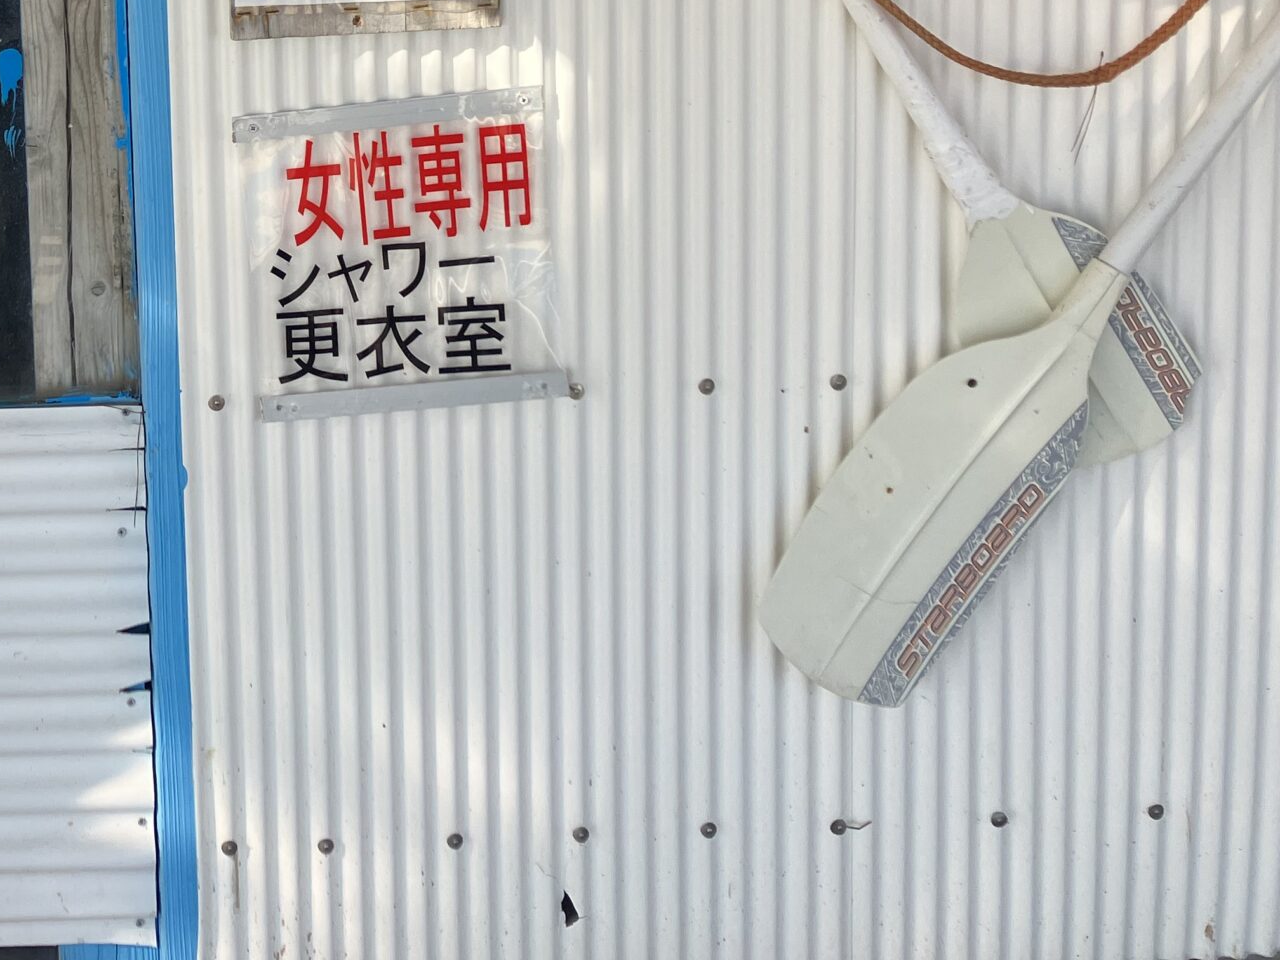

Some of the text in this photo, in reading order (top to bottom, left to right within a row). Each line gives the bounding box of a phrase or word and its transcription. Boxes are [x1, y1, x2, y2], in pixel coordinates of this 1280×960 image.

[286, 123, 531, 246] 女性専用
[270, 241, 495, 307] シャワー
[276, 296, 512, 384] 更衣室
[896, 482, 1045, 679] STARBOARD
